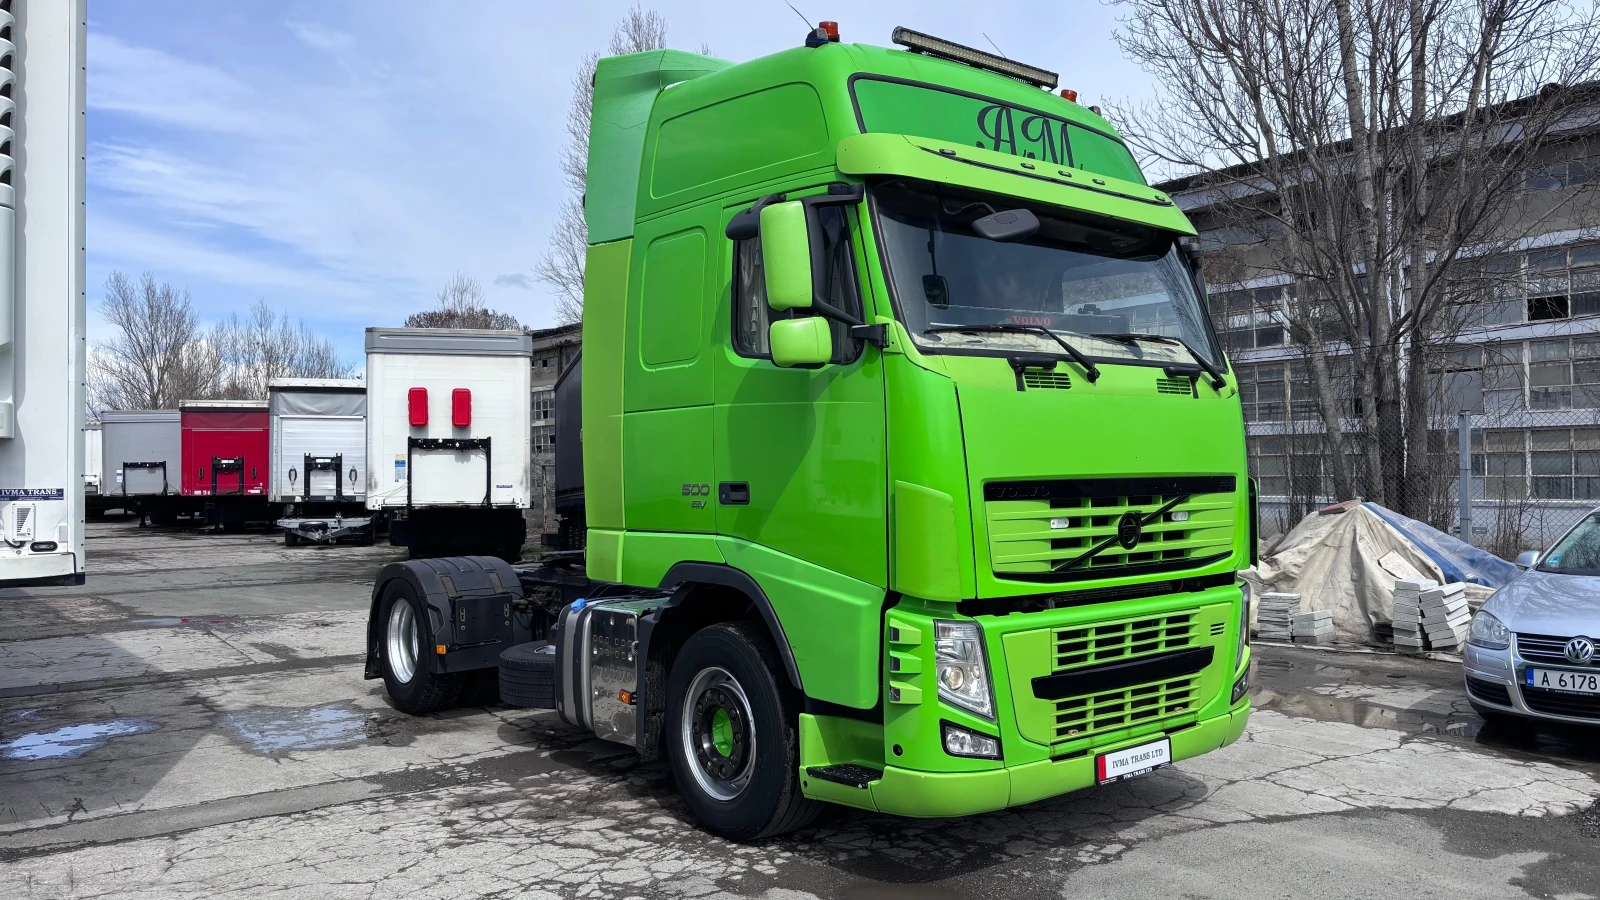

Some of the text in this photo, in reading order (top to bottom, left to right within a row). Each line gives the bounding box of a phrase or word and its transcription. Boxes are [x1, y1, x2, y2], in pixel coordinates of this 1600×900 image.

[1012, 315, 1051, 326] VOLVO
[682, 483, 710, 496] 500
[1541, 671, 1598, 690] A 6178
[1112, 748, 1164, 769] IVMA TRANS LTD
[1133, 768, 1145, 777] TRANS
